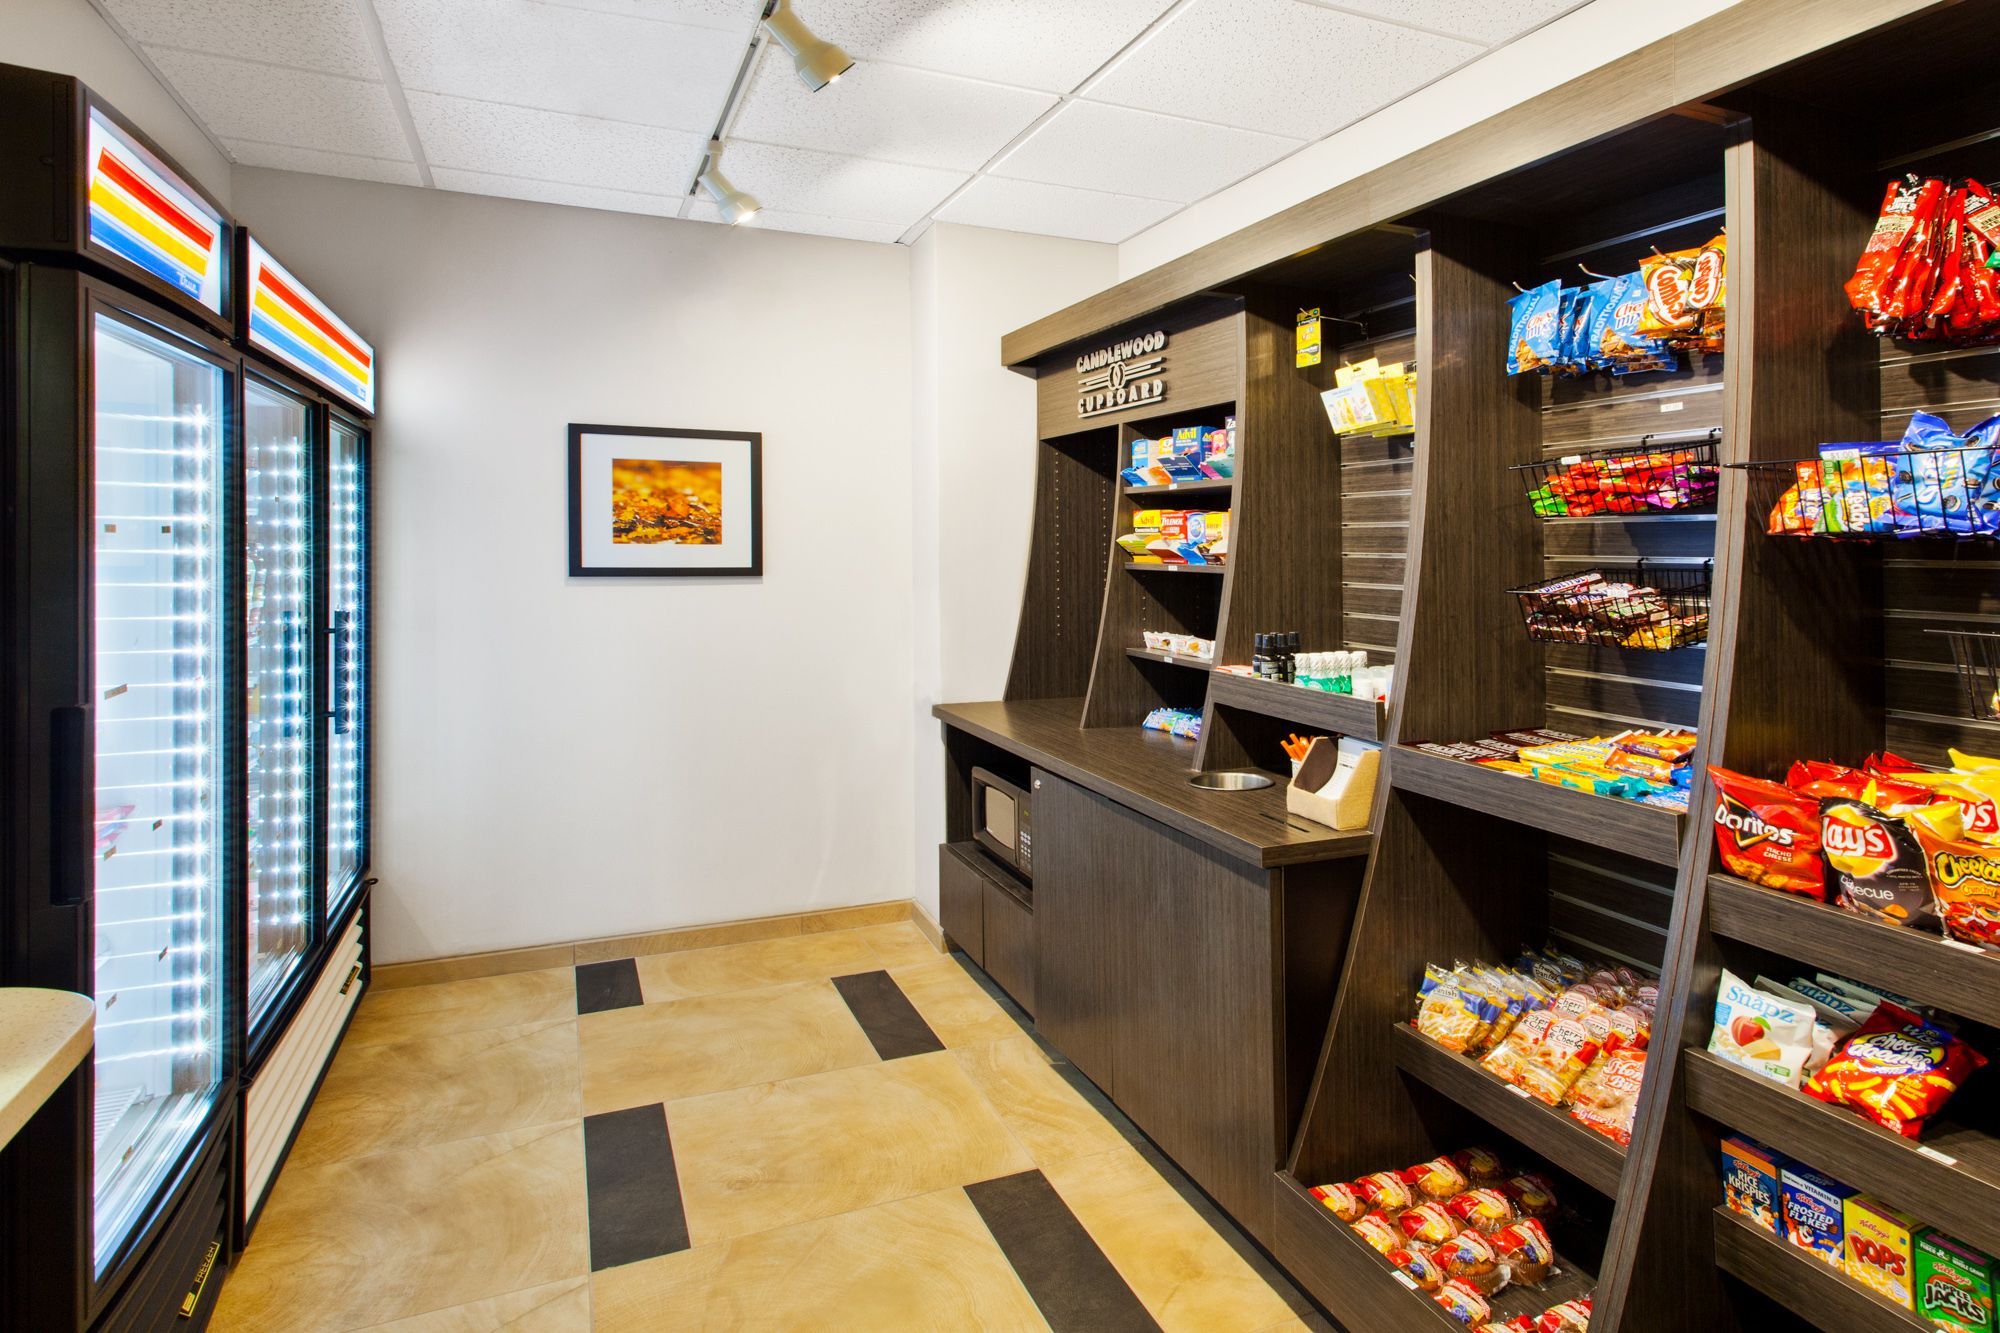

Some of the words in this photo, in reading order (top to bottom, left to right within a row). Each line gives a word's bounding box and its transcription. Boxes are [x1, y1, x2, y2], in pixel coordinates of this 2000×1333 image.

[1615, 301, 1645, 318] Che
[1508, 295, 1541, 357] TRADITIONAL
[1076, 330, 1165, 374] CANDLEWOOD
[1077, 379, 1163, 414] CUPBOARD
[1177, 427, 1197, 440] Advil
[1714, 803, 1794, 846] Doritos
[1960, 801, 1993, 831] y's
[1822, 817, 1885, 857] Lay's
[1763, 852, 1793, 863] CHEESE
[1766, 847, 1792, 858] NACHO
[1728, 1173, 1770, 1206] KRISPIES
[1737, 1169, 1758, 1189] RICE
[1804, 1183, 1832, 1202] VITAMIN
[1788, 1201, 1834, 1225] FROSTED
[1789, 1210, 1828, 1231] FLAKES
[194, 1246, 215, 1283] FREEZER
[1846, 1232, 1907, 1277] POPS
[1923, 1283, 1987, 1325] JACKS
[1933, 1280, 1972, 1303] APPLE
